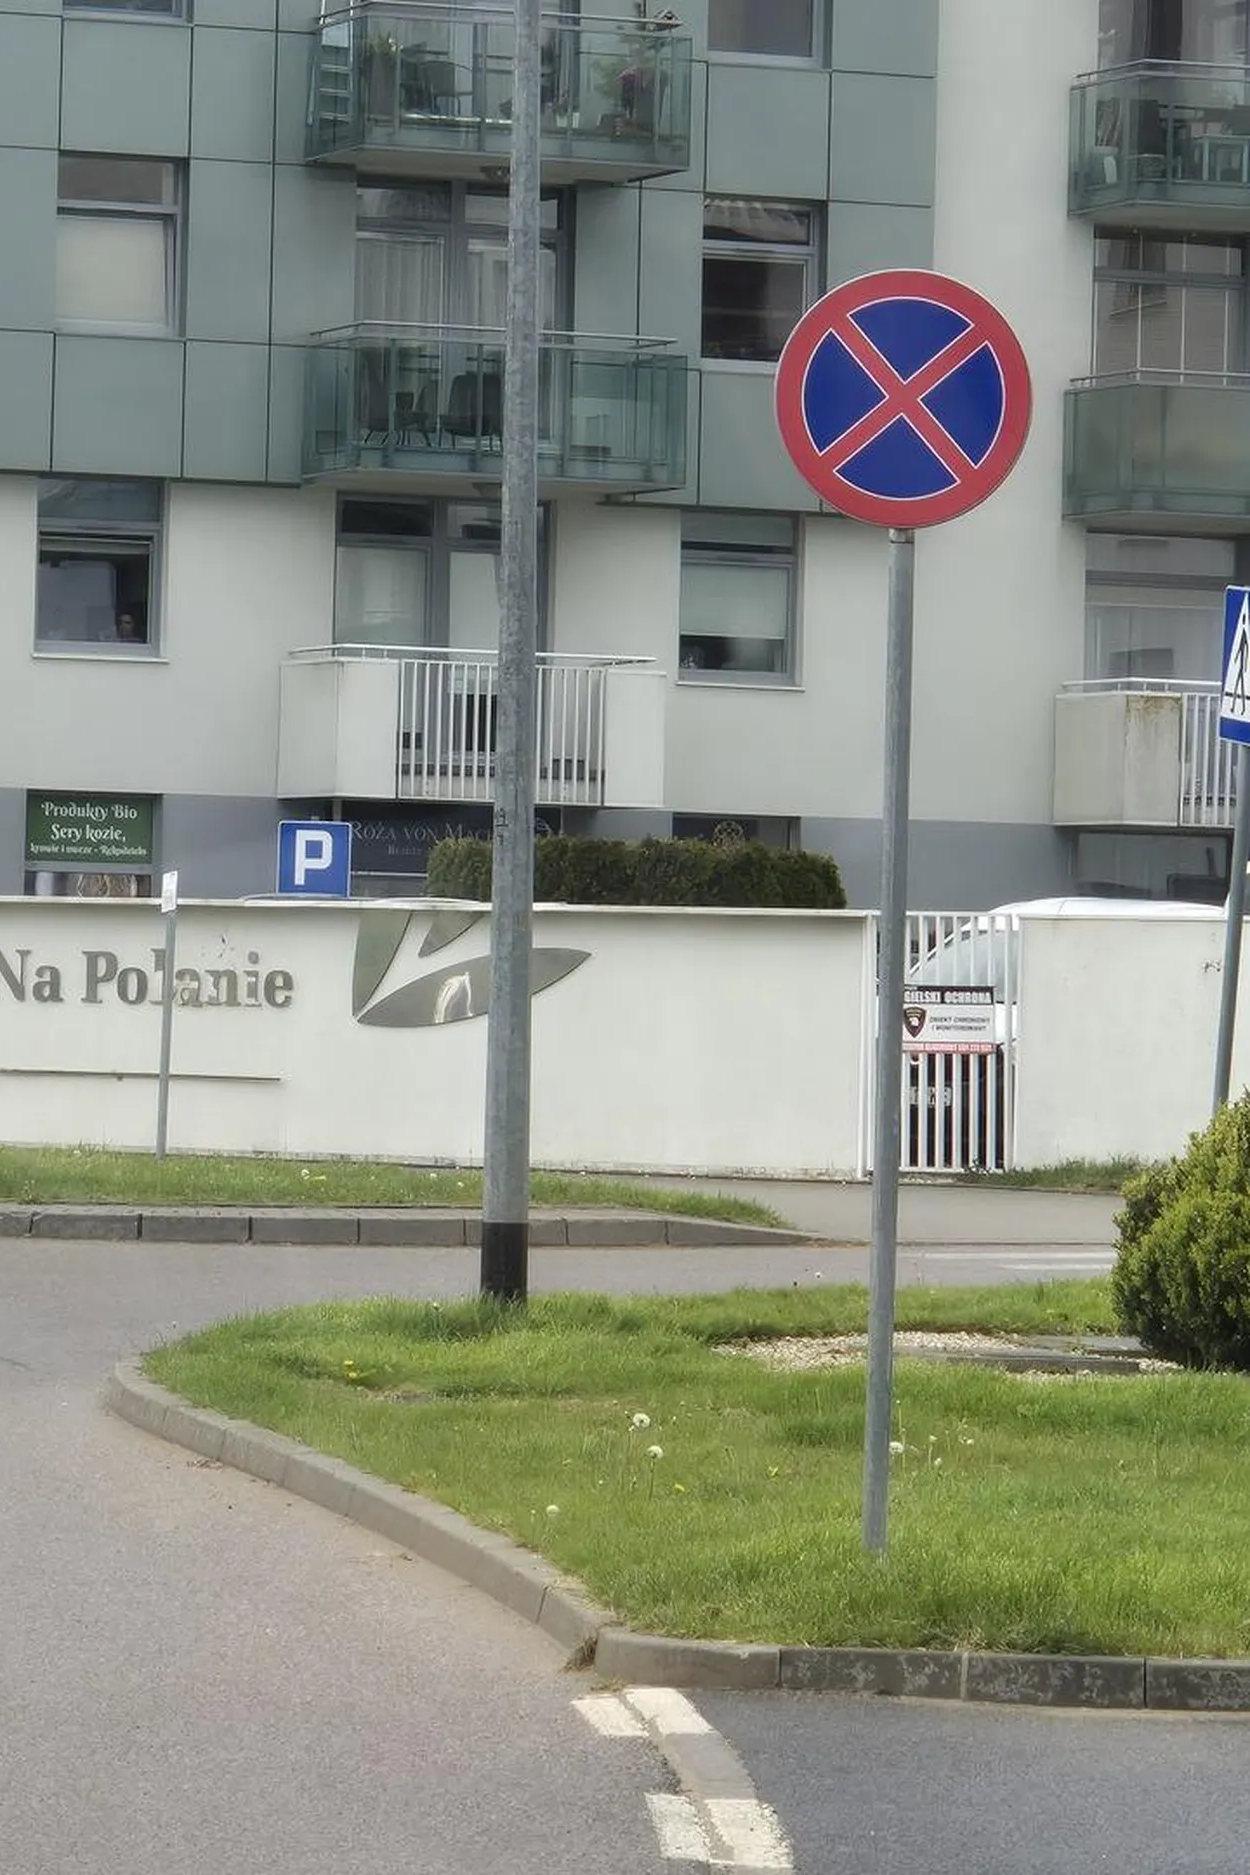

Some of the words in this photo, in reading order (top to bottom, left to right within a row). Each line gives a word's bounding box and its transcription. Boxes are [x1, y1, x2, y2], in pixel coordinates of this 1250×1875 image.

[41, 801, 108, 822] Produkty
[111, 804, 138, 819] Bio
[51, 823, 83, 843] Sery
[85, 824, 126, 843] kozie,
[294, 829, 333, 886] P
[81, 947, 294, 1008] Polanie
